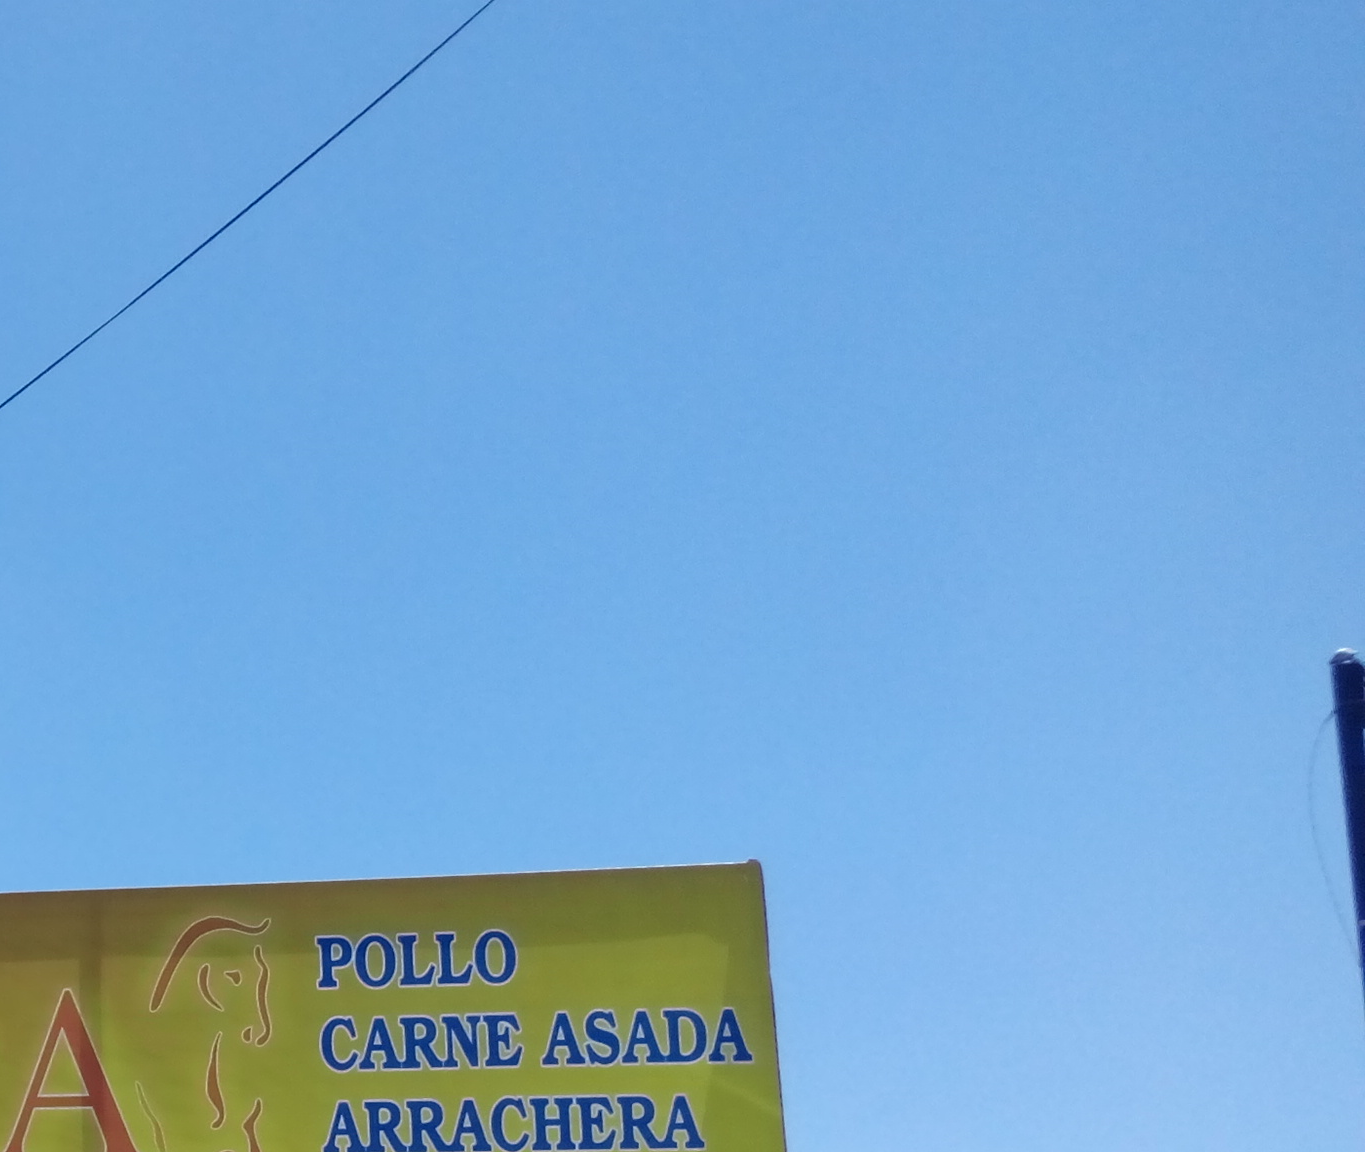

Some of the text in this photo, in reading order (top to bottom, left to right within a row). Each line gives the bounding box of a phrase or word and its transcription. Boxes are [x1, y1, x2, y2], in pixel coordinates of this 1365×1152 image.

[315, 928, 518, 990] POLLO
[319, 1007, 755, 1072] CARNE ASADA
